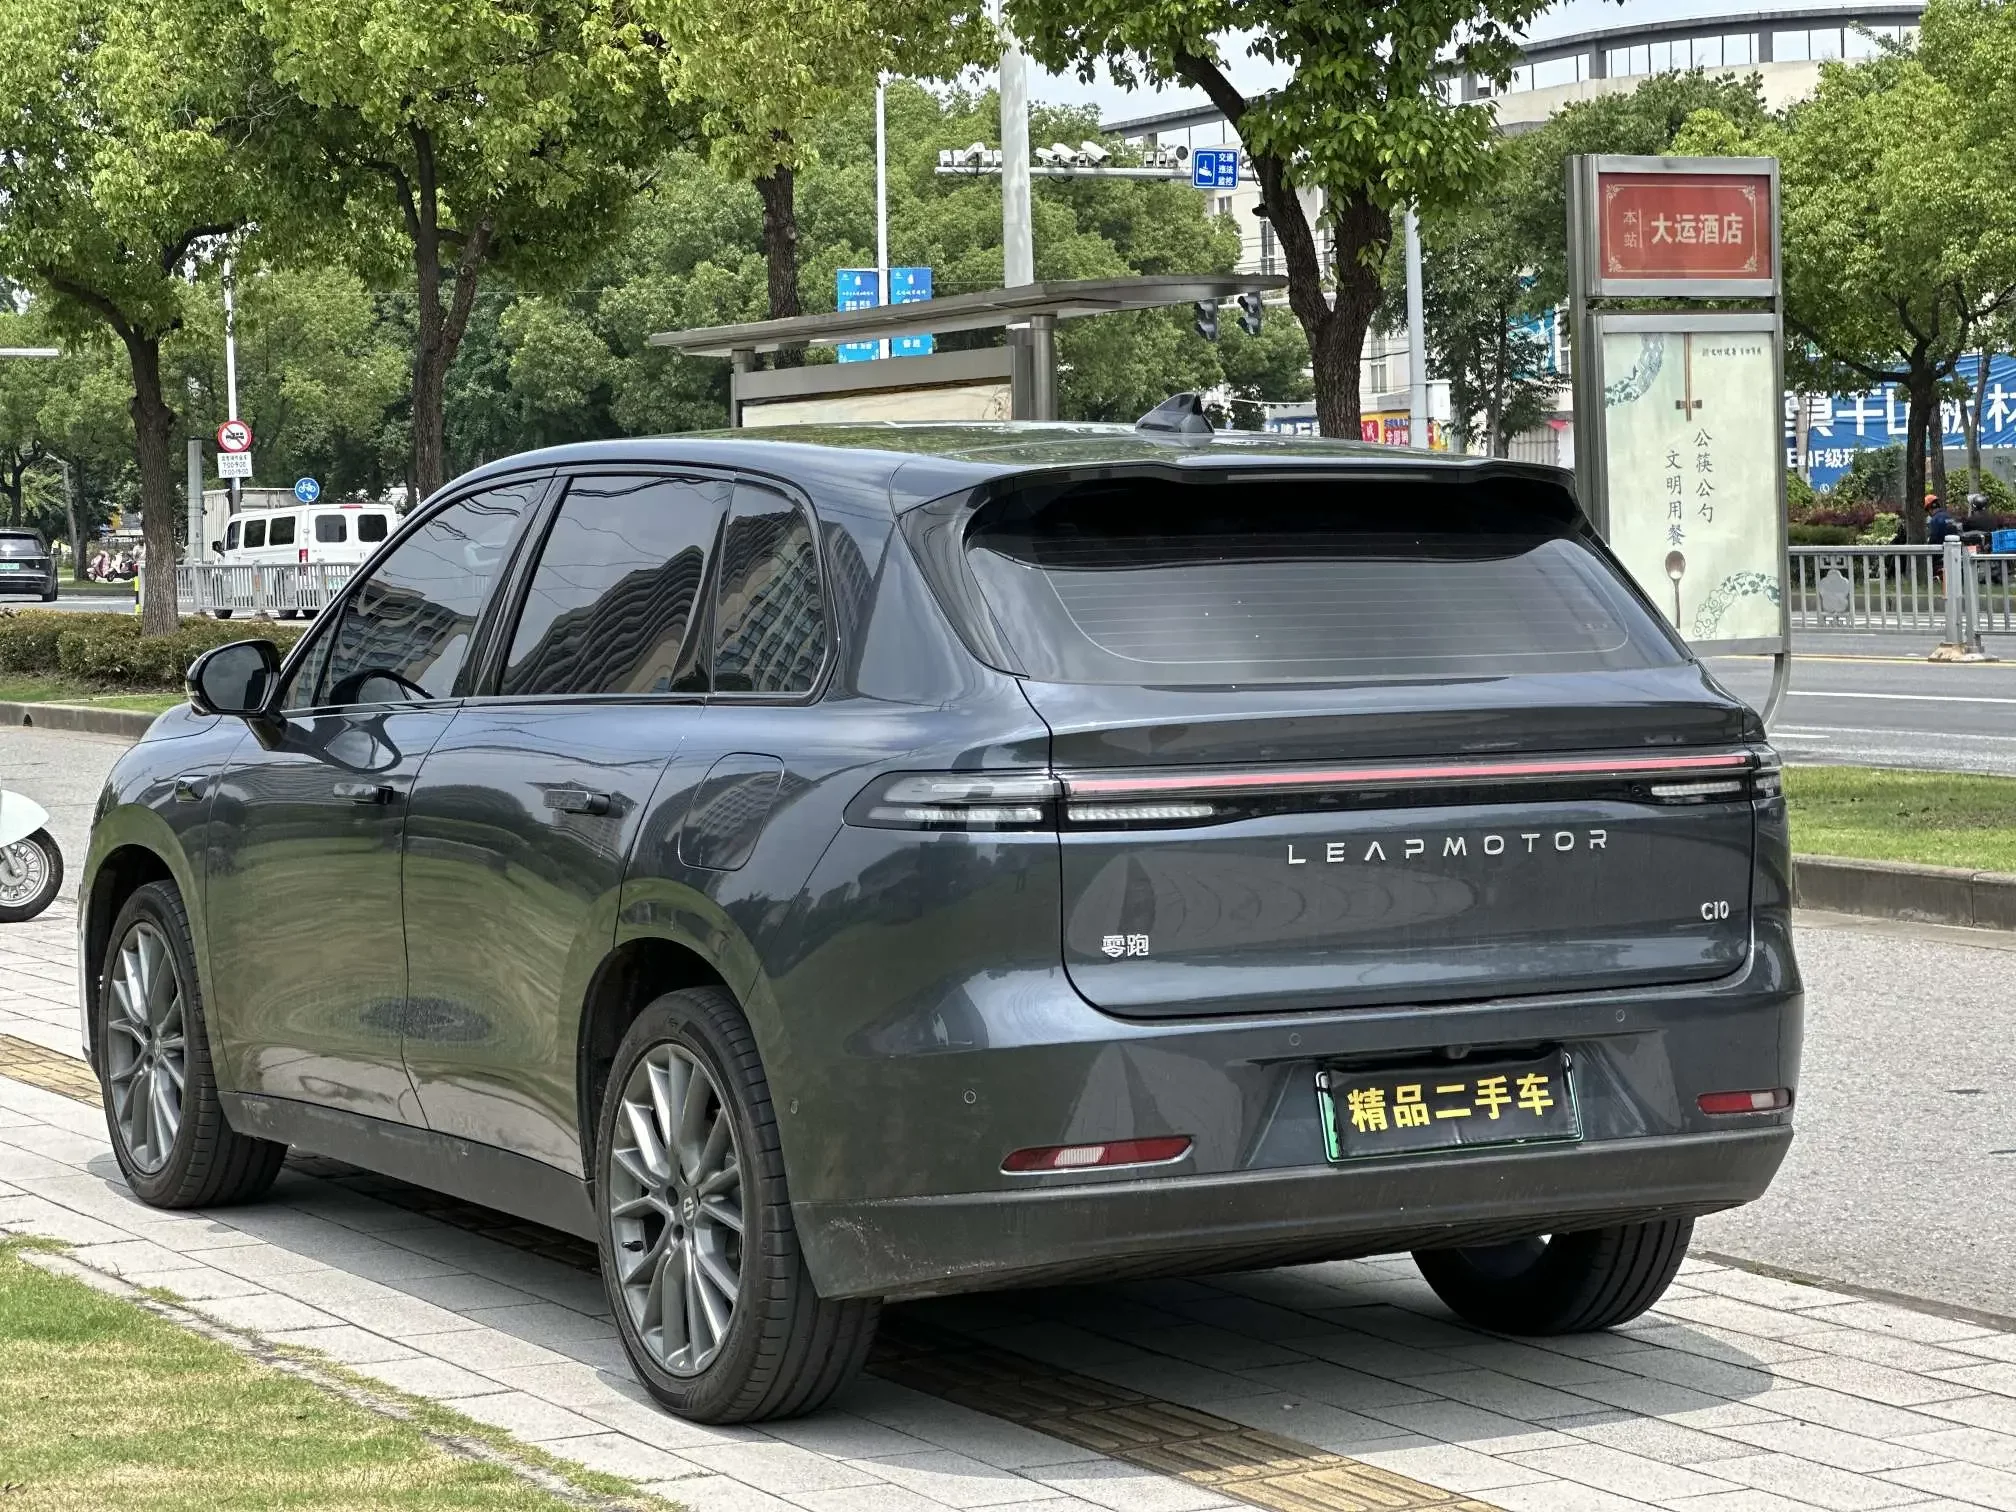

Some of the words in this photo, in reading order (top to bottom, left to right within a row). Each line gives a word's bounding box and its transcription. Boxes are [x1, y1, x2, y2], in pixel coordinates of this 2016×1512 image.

[1623, 209, 1638, 248] 本站
[1651, 212, 1743, 245] 大运酒店
[1693, 428, 1715, 523] 公筷公勺
[1665, 449, 1686, 546] 文明用餐
[1288, 829, 1607, 864] LEAPMOTOR
[1701, 900, 1730, 921] C10
[1101, 934, 1149, 957] 零跑
[1347, 1072, 1554, 1133] 精品二手车
